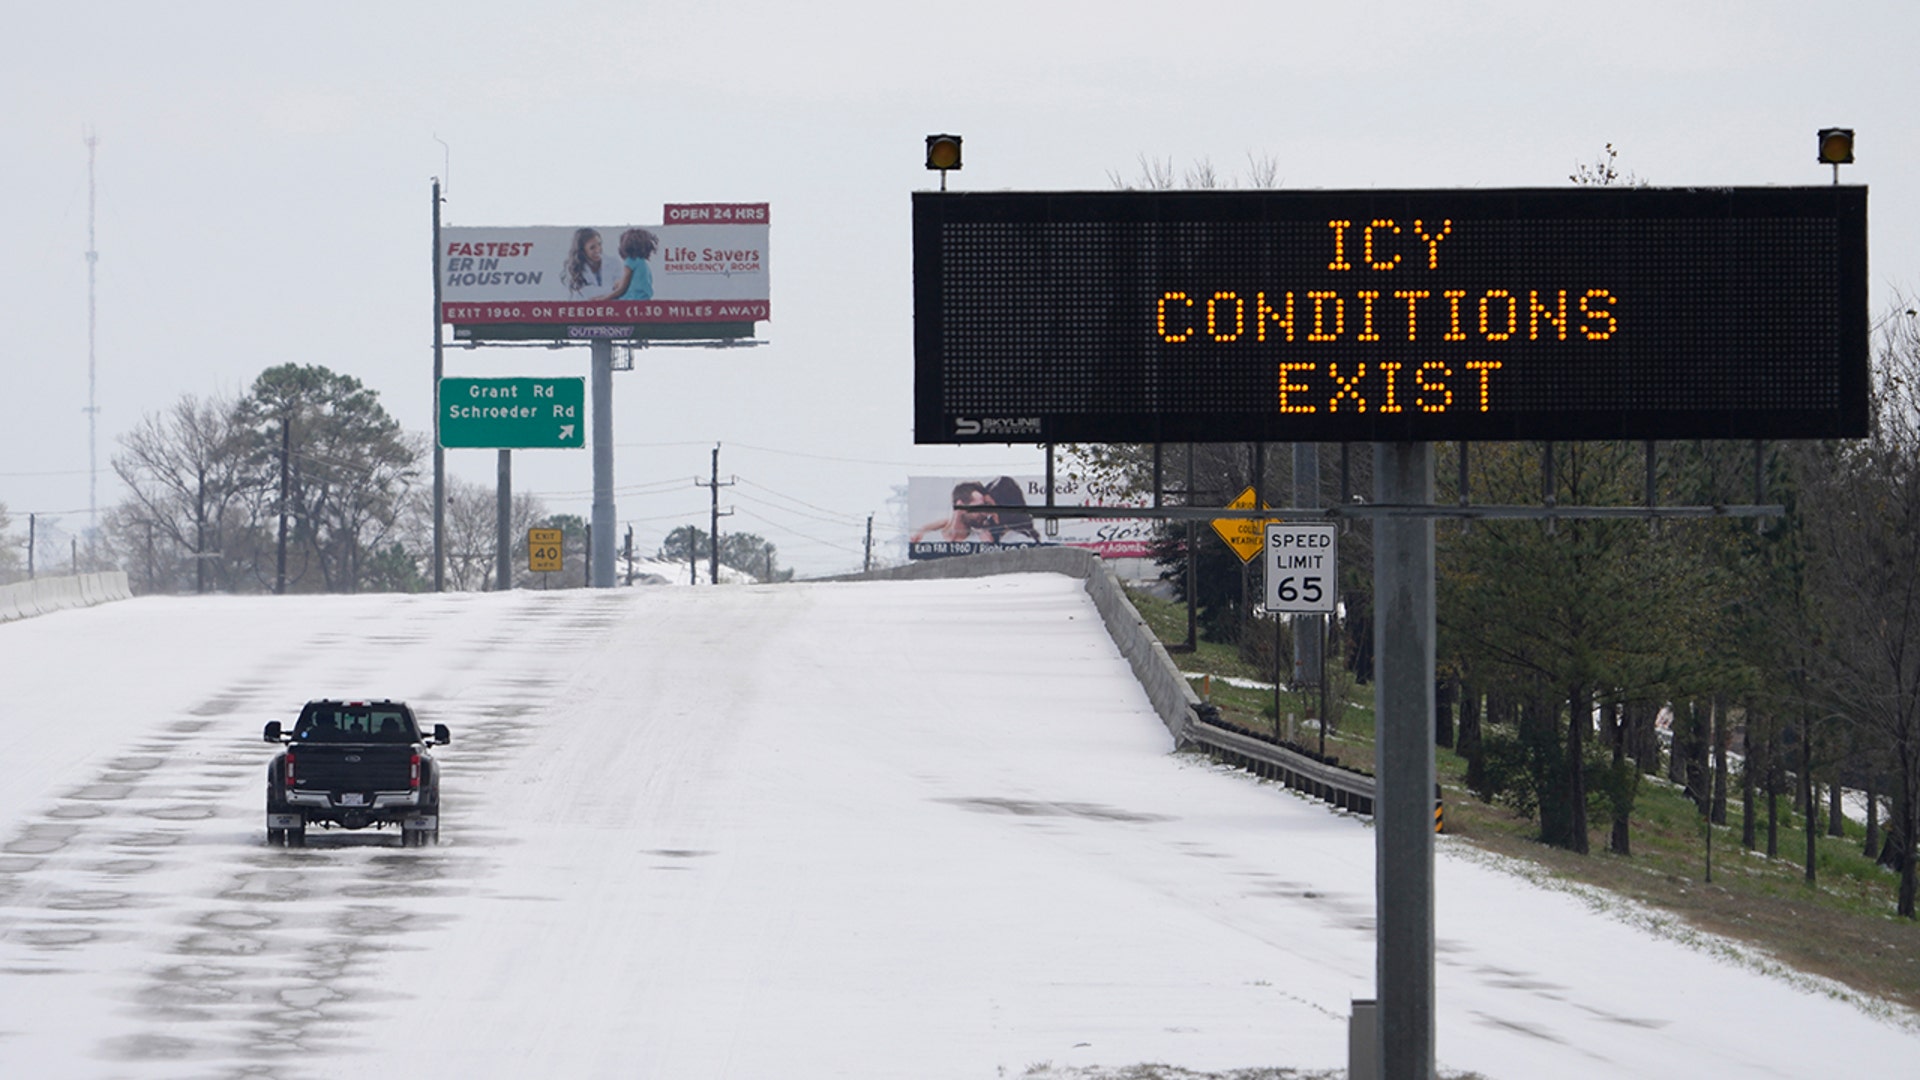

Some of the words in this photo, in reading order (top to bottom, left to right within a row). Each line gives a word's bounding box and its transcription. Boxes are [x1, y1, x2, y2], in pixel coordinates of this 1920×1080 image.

[669, 208, 710, 220] OPEN
[714, 208, 733, 220] 24
[735, 207, 766, 220] HRS
[447, 242, 534, 257] FASTEST
[1326, 217, 1453, 272] ICY
[663, 247, 698, 262] Life
[702, 246, 760, 262] Savers
[447, 258, 475, 271] ER
[478, 258, 499, 271] IN
[663, 262, 725, 272] EMERGENCY
[730, 262, 760, 271] ROOM
[447, 271, 543, 287] HOUSTON
[447, 307, 481, 319] EXIT
[532, 306, 552, 318] ON
[625, 306, 663, 318] (1.30
[669, 306, 713, 318] MILES
[719, 305, 767, 318] AWAY)
[1155, 288, 1620, 343] CONDITIONS
[469, 384, 518, 398] Grant
[533, 384, 554, 397] Rd
[1276, 360, 1504, 415] EXIST
[449, 404, 538, 418] Schroeder
[553, 404, 575, 417] Rd
[982, 417, 1041, 428] SKYLINE
[1028, 481, 1079, 495] Boed?
[1271, 533, 1331, 548] SPEED
[535, 546, 558, 560] 40
[1277, 555, 1324, 569] LIMIT
[1277, 576, 1323, 602] 65
